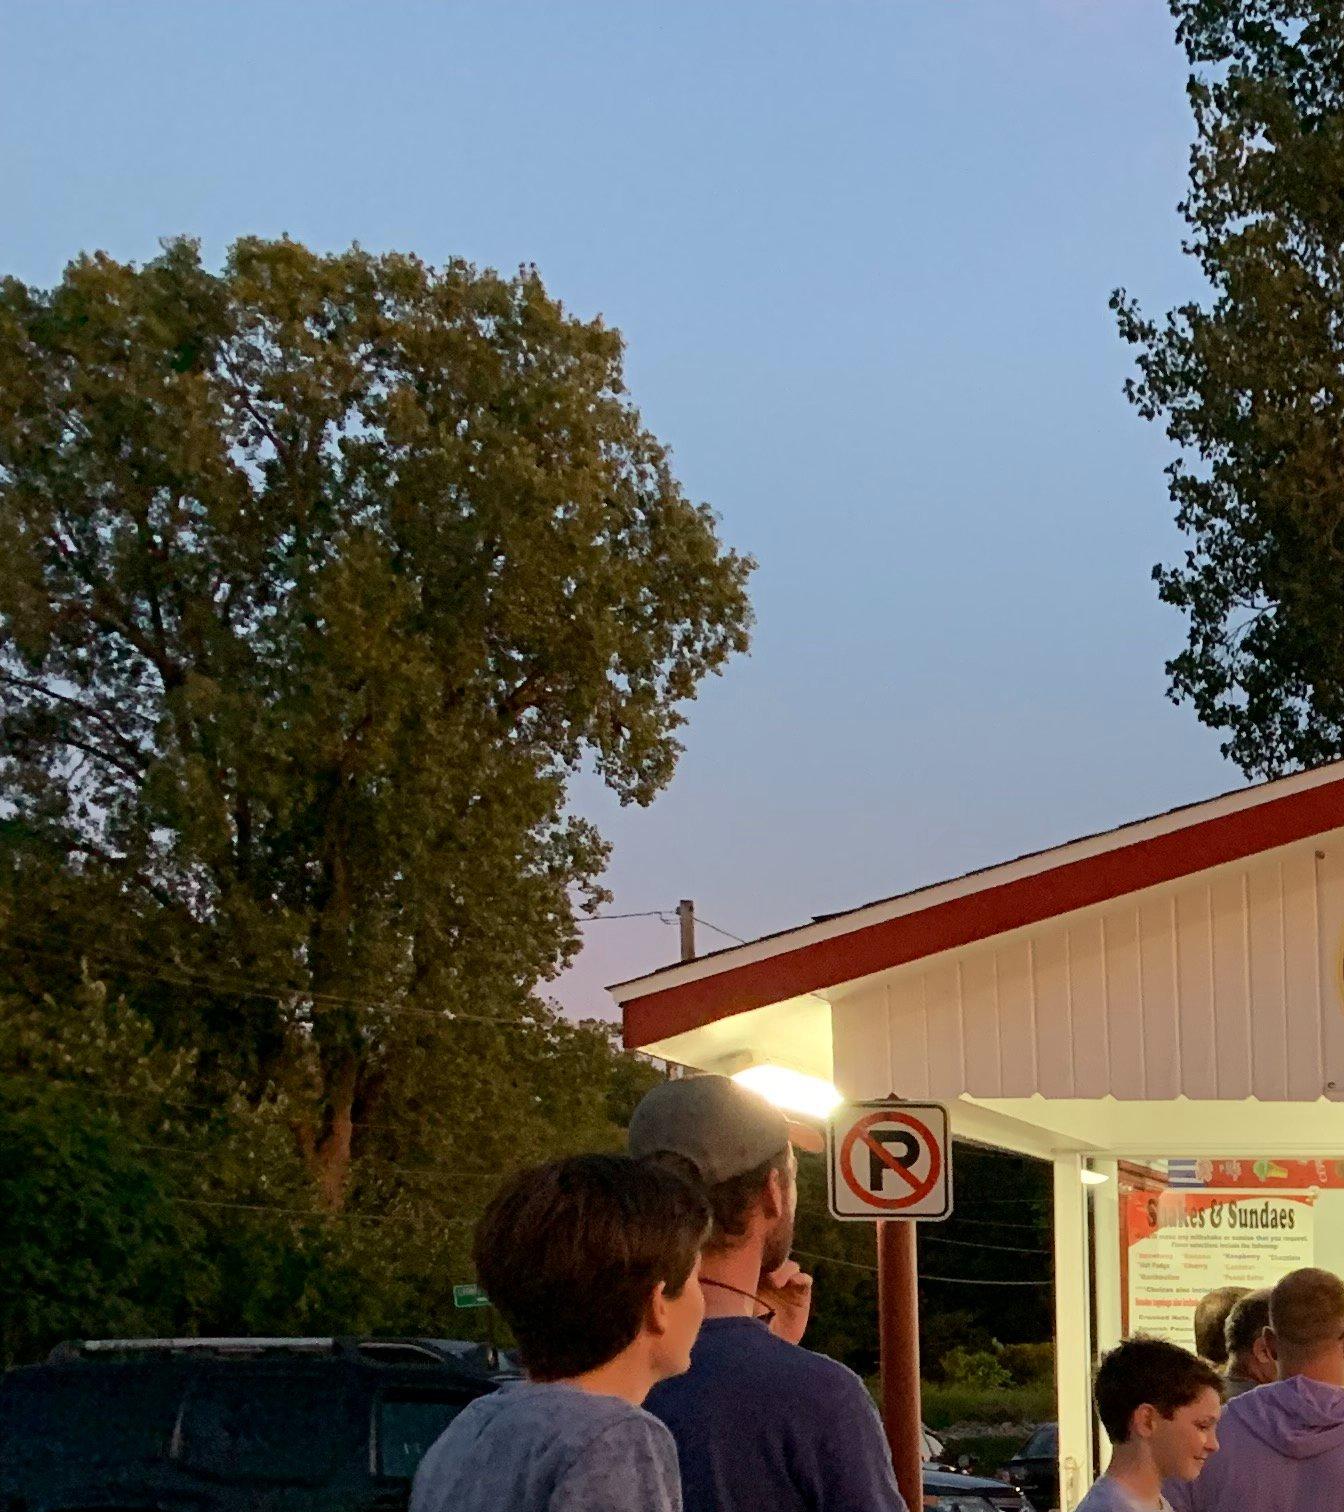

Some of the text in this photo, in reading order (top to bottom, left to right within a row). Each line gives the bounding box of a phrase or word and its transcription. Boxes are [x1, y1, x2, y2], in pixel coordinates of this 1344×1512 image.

[1148, 1199, 1295, 1229] Skes & Sundaes
